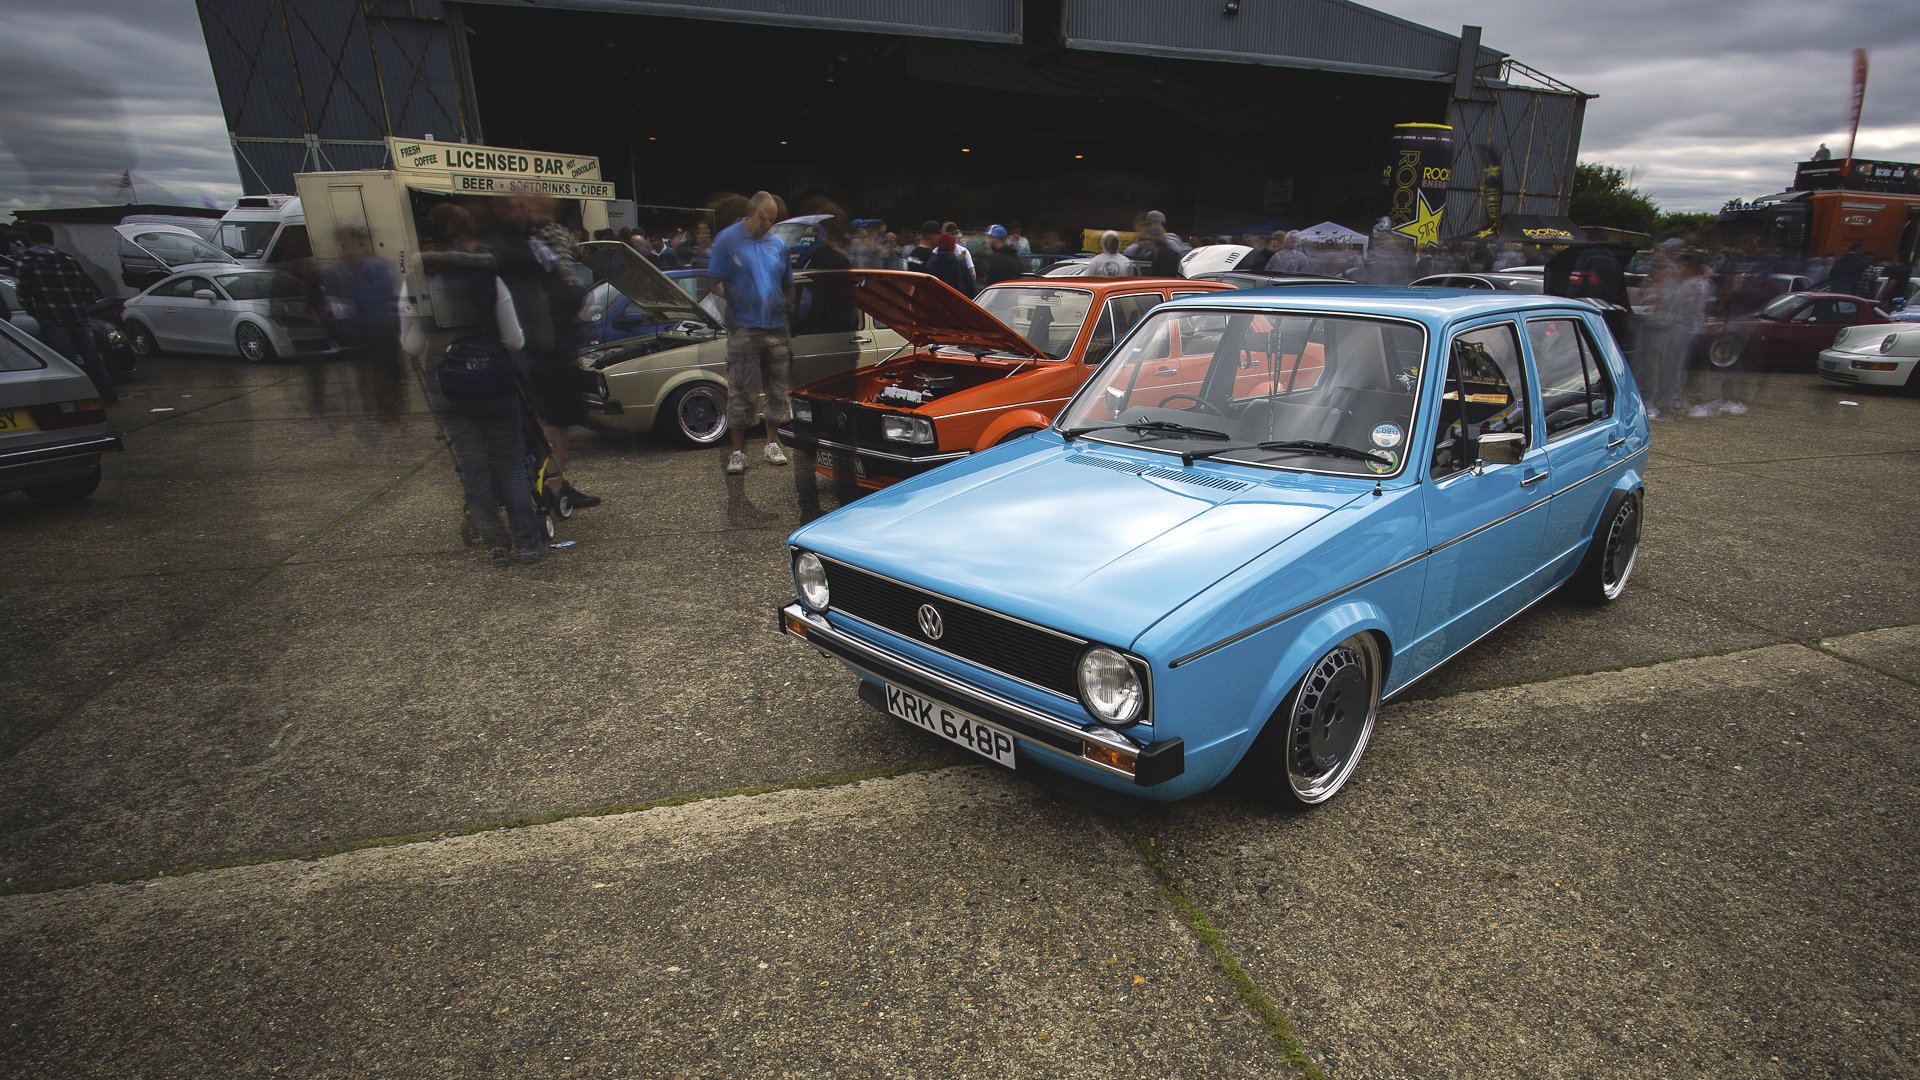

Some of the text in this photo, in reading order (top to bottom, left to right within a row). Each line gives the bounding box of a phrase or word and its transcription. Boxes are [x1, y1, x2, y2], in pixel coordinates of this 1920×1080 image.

[400, 144, 422, 158] FRESH
[414, 154, 438, 167] COFFEE
[445, 149, 564, 175] LICENSED BAR
[566, 159, 576, 170] HOT
[571, 160, 597, 178] CHOCOLATE
[462, 177, 494, 191] BEER
[580, 184, 608, 196] CIDER
[887, 684, 1012, 761] KRK 648P
